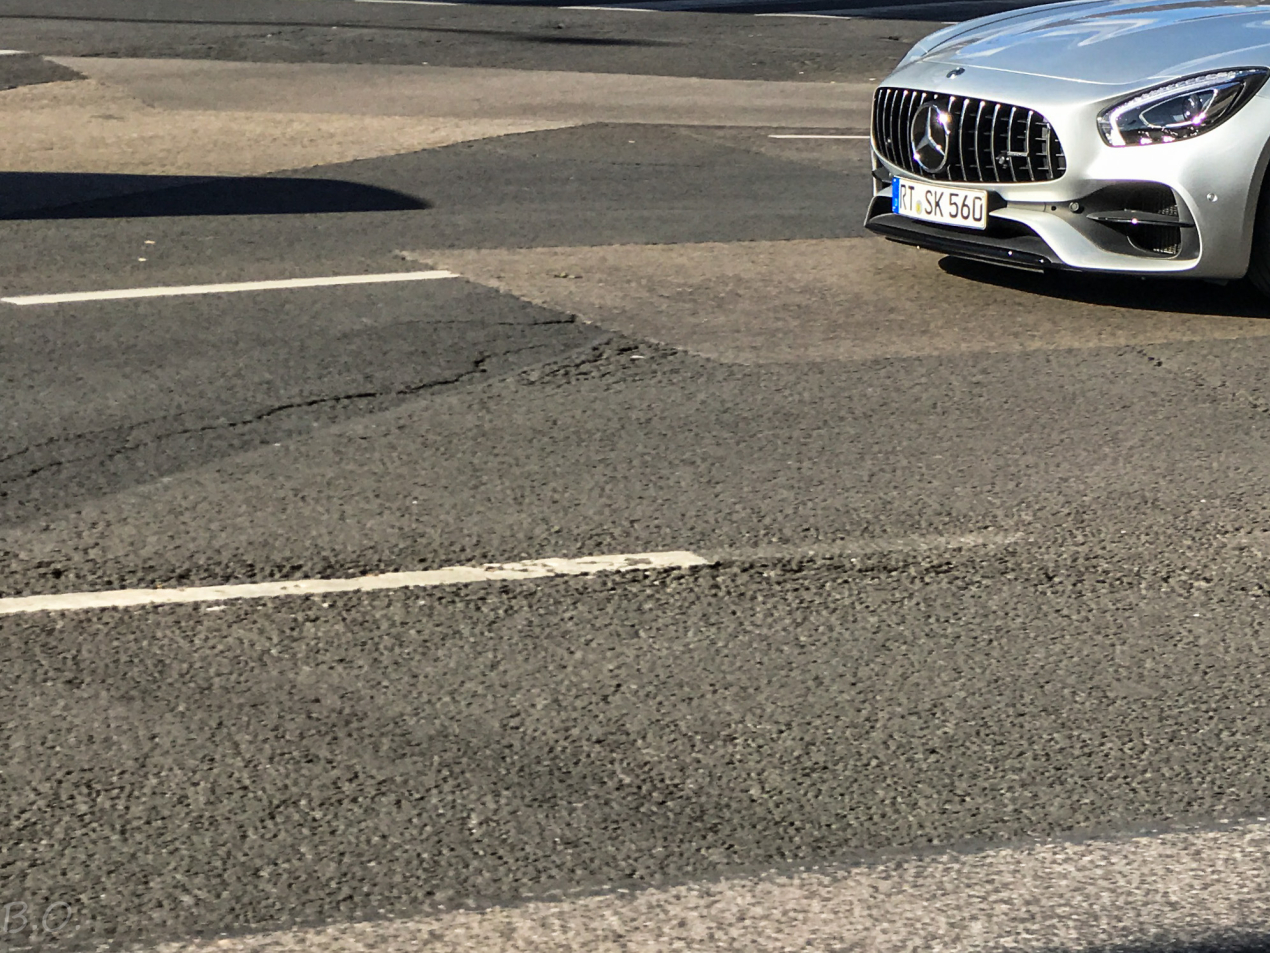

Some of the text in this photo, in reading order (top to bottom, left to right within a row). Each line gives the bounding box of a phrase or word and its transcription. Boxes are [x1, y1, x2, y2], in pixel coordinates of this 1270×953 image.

[900, 184, 983, 222] RT SK 560
